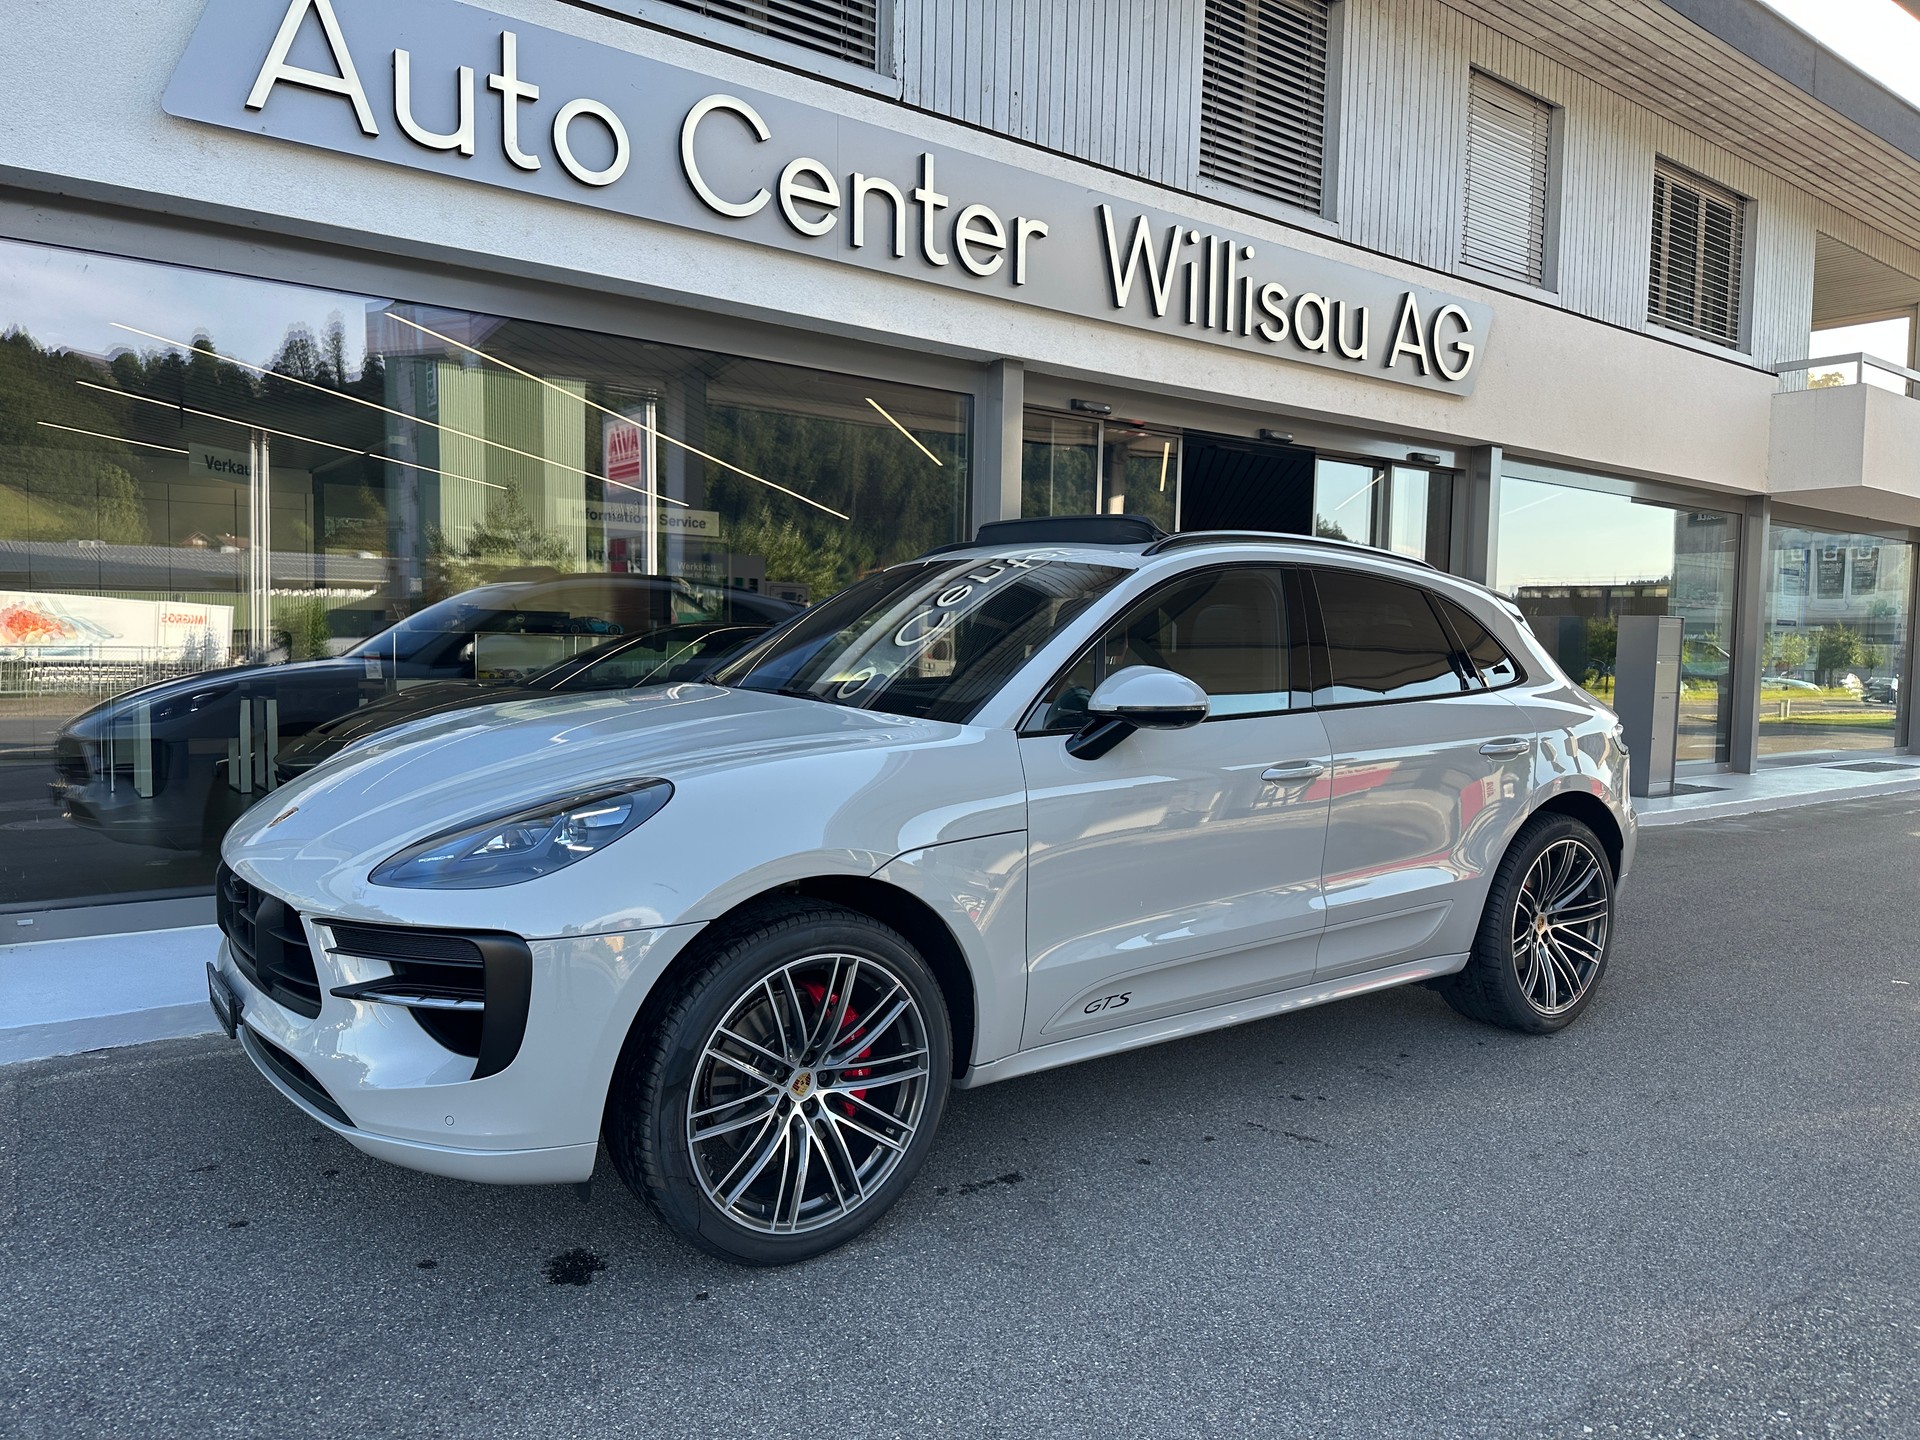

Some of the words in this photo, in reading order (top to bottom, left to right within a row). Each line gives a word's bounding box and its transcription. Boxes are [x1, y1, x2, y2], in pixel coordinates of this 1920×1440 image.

[245, 0, 631, 188] Auto
[679, 94, 1049, 287] Center
[1099, 203, 1370, 362] Willisau
[1385, 290, 1476, 382] AG
[204, 454, 253, 476] Verkau
[659, 514, 706, 529] Service
[1084, 991, 1132, 1014] GTS
